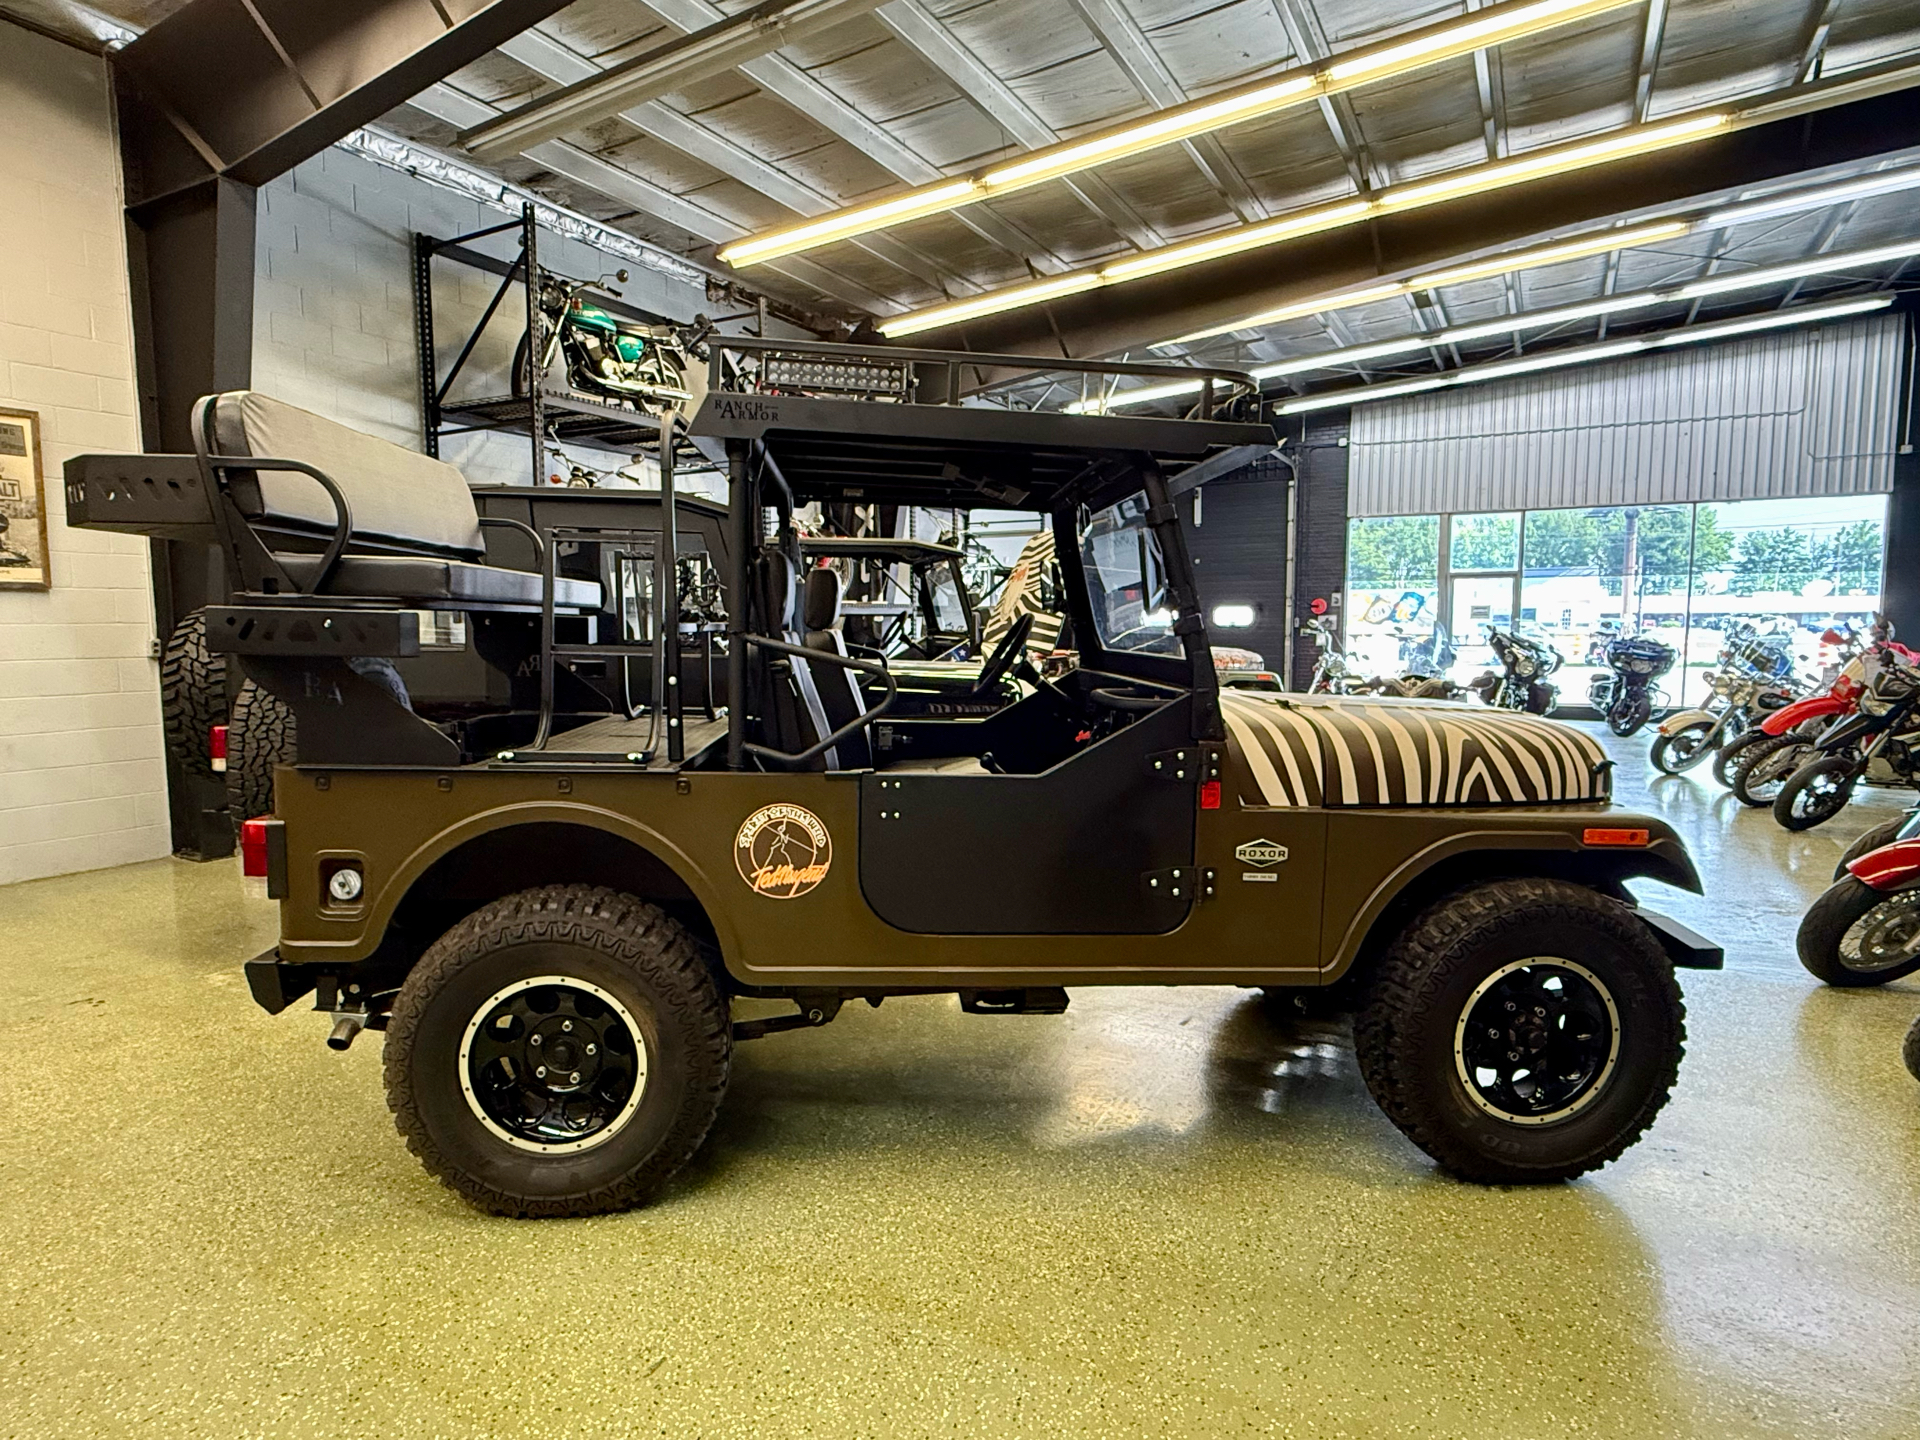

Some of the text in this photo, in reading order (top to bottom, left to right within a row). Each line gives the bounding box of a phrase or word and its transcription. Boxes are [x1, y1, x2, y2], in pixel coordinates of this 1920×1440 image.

[714, 399, 763, 417] RANCH
[720, 401, 779, 421] ARMOR
[739, 807, 826, 848] SPIRIT OF THE WILD
[1238, 849, 1286, 858] ROXOR
